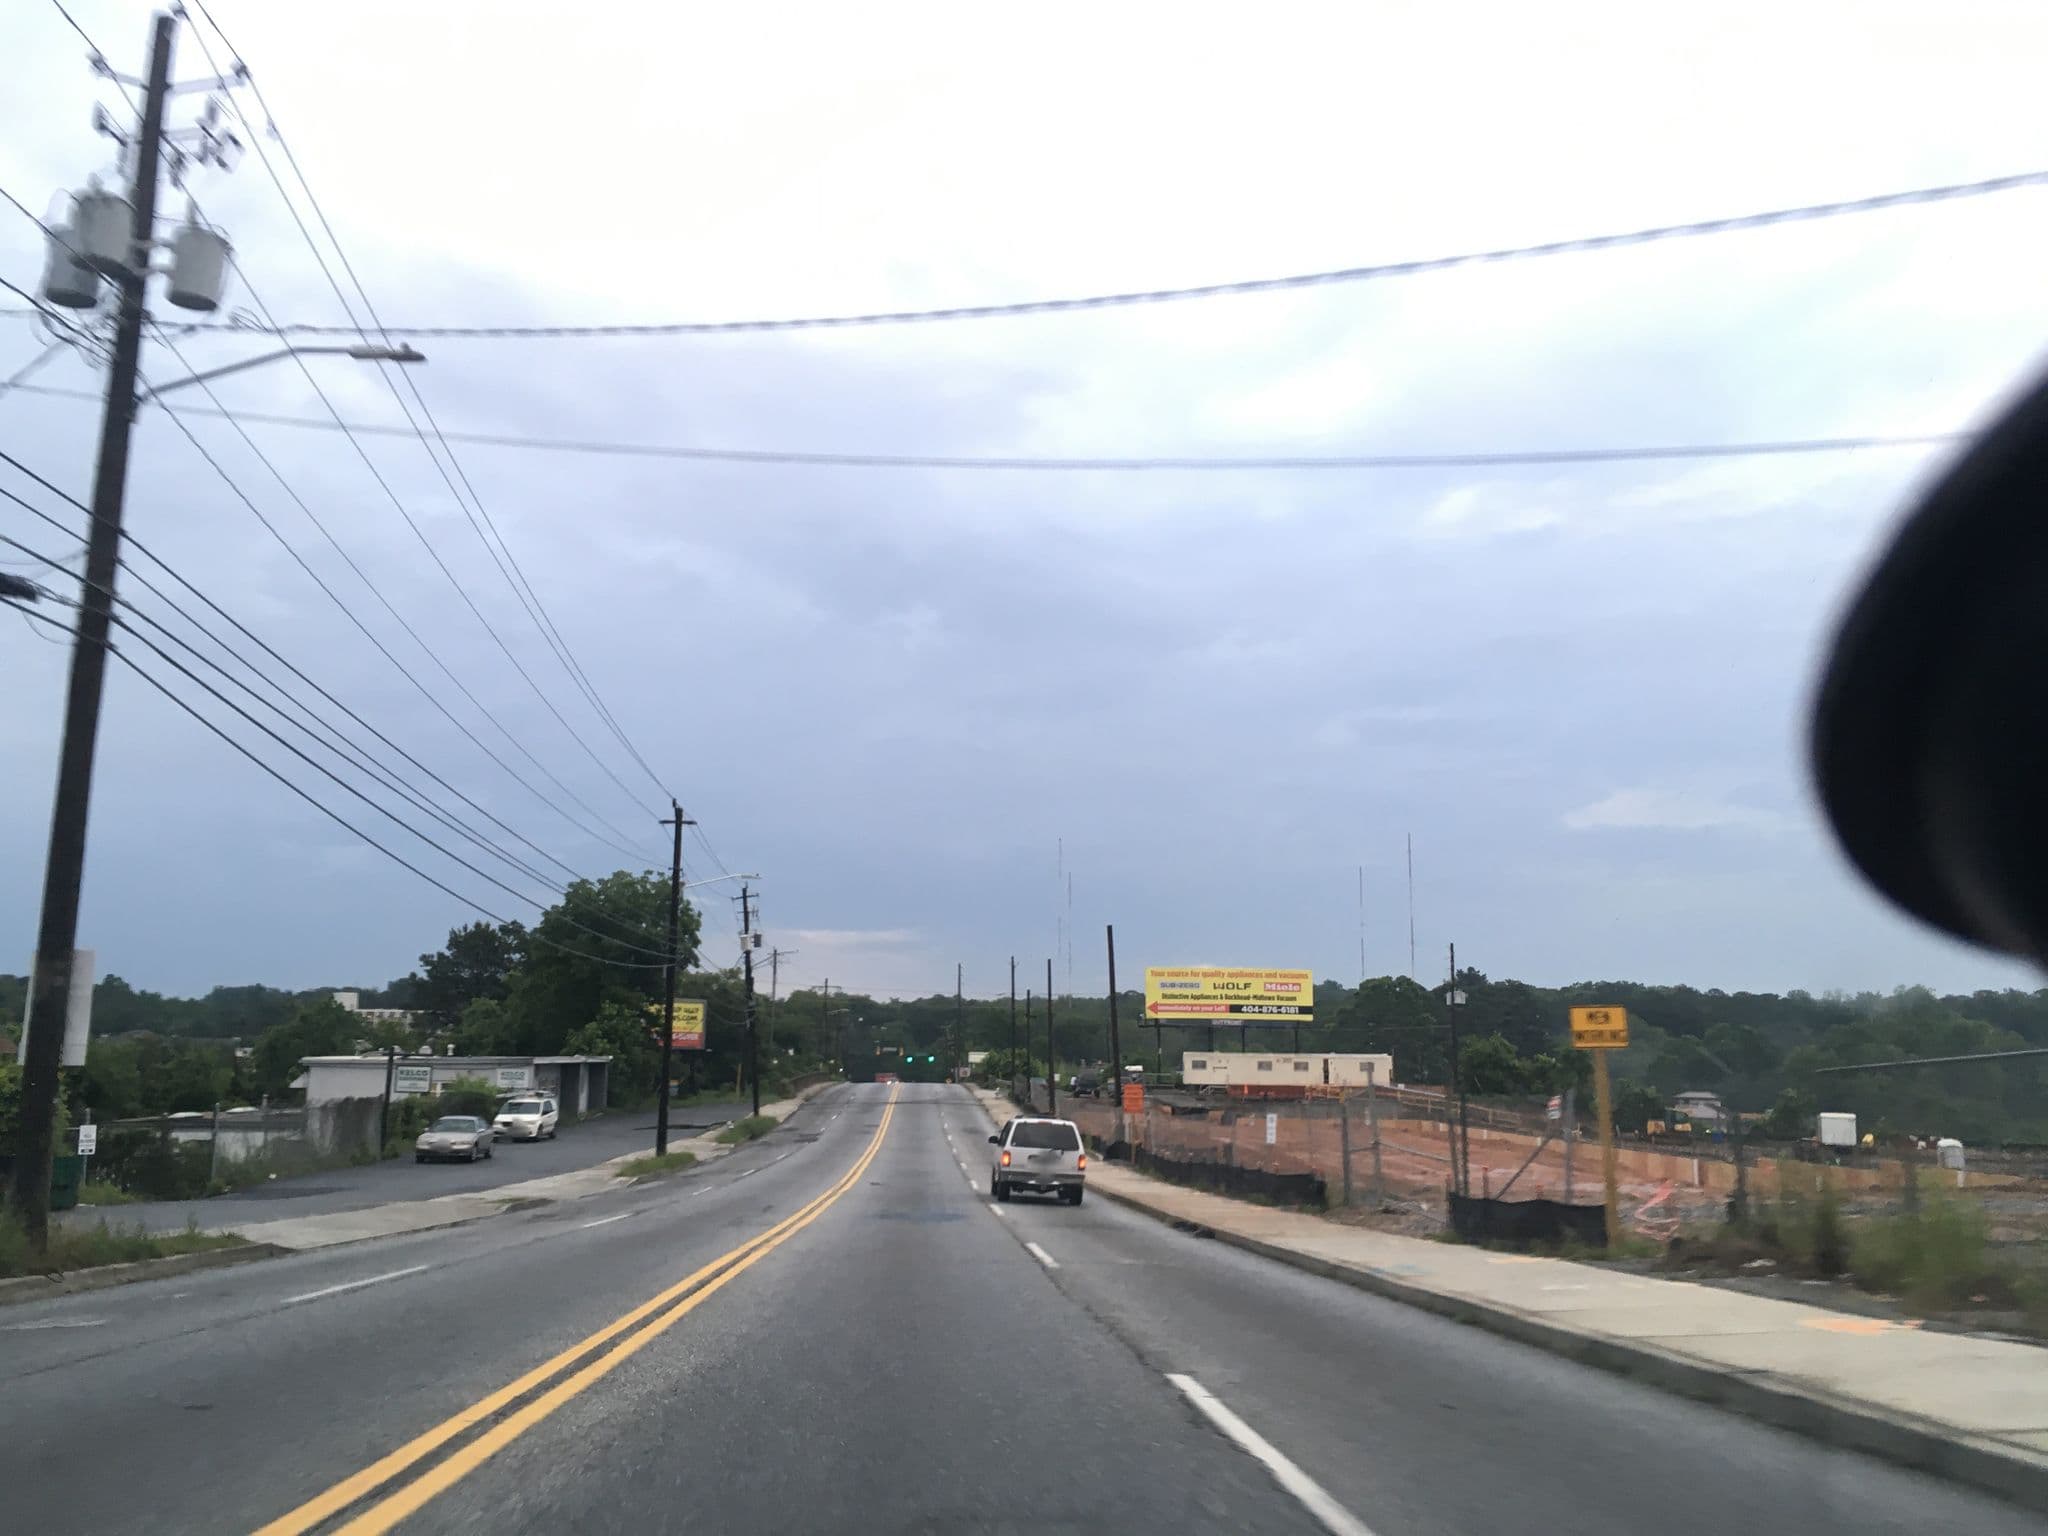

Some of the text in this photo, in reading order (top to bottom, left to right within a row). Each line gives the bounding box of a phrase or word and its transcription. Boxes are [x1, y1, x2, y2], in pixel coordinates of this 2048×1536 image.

[1202, 970, 1225, 978] quality
[1227, 970, 1263, 979] appliances
[1213, 982, 1252, 990] WOLF
[1264, 983, 1300, 991] Miele
[1241, 1005, 1299, 1014] 404-876-6181
